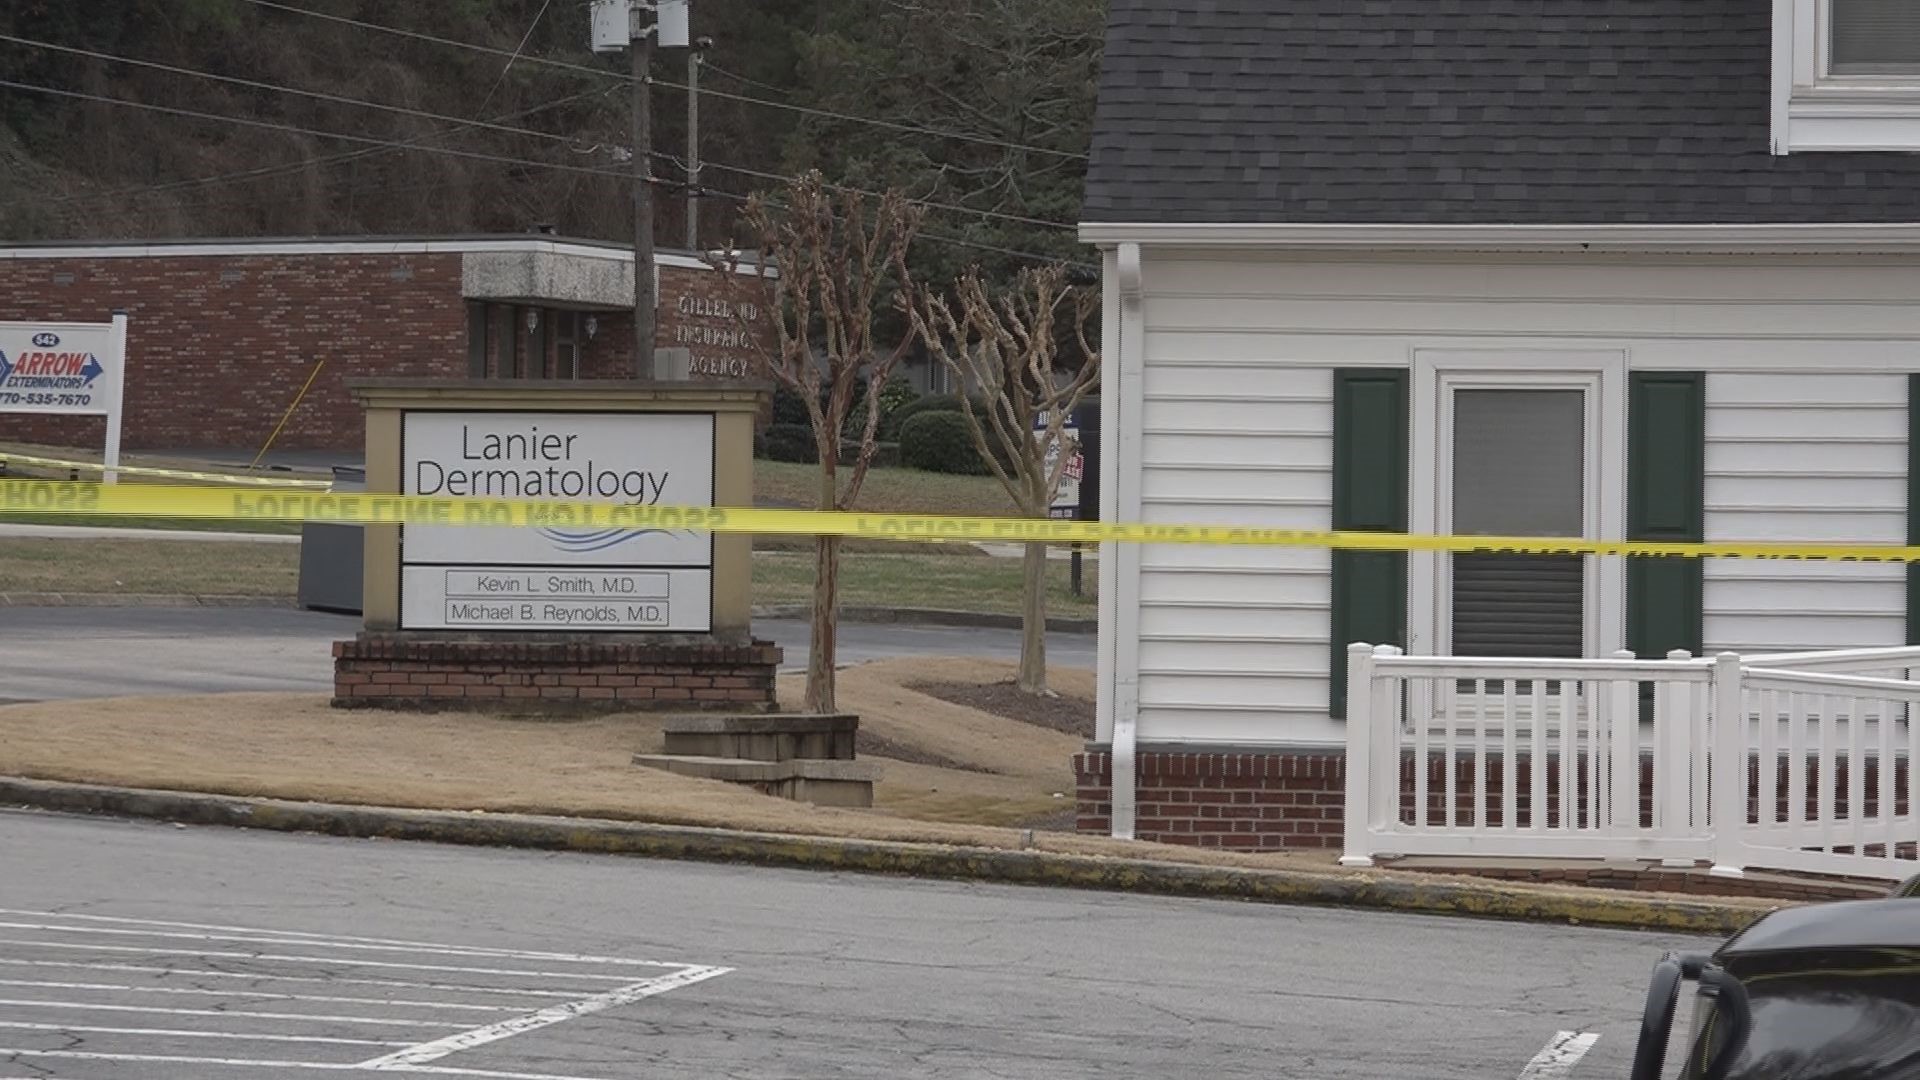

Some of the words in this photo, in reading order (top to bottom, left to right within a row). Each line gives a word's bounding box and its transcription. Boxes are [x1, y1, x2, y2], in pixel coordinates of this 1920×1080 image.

[679, 296, 757, 320] GILLELND
[676, 325, 755, 350] INSURANC
[13, 352, 87, 375] ARROW
[689, 355, 748, 376] AGENCY
[7, 376, 83, 389] EXTERMINATORS
[463, 425, 577, 461] Lanier
[416, 460, 669, 506] Dermatology
[477, 576, 520, 592] Kevin
[547, 576, 596, 595] Smith,
[602, 577, 638, 593] M.D.
[451, 604, 514, 620] Michael
[520, 605, 536, 620] B.
[543, 605, 621, 624] Reynolds,
[627, 606, 663, 622] M.D.
